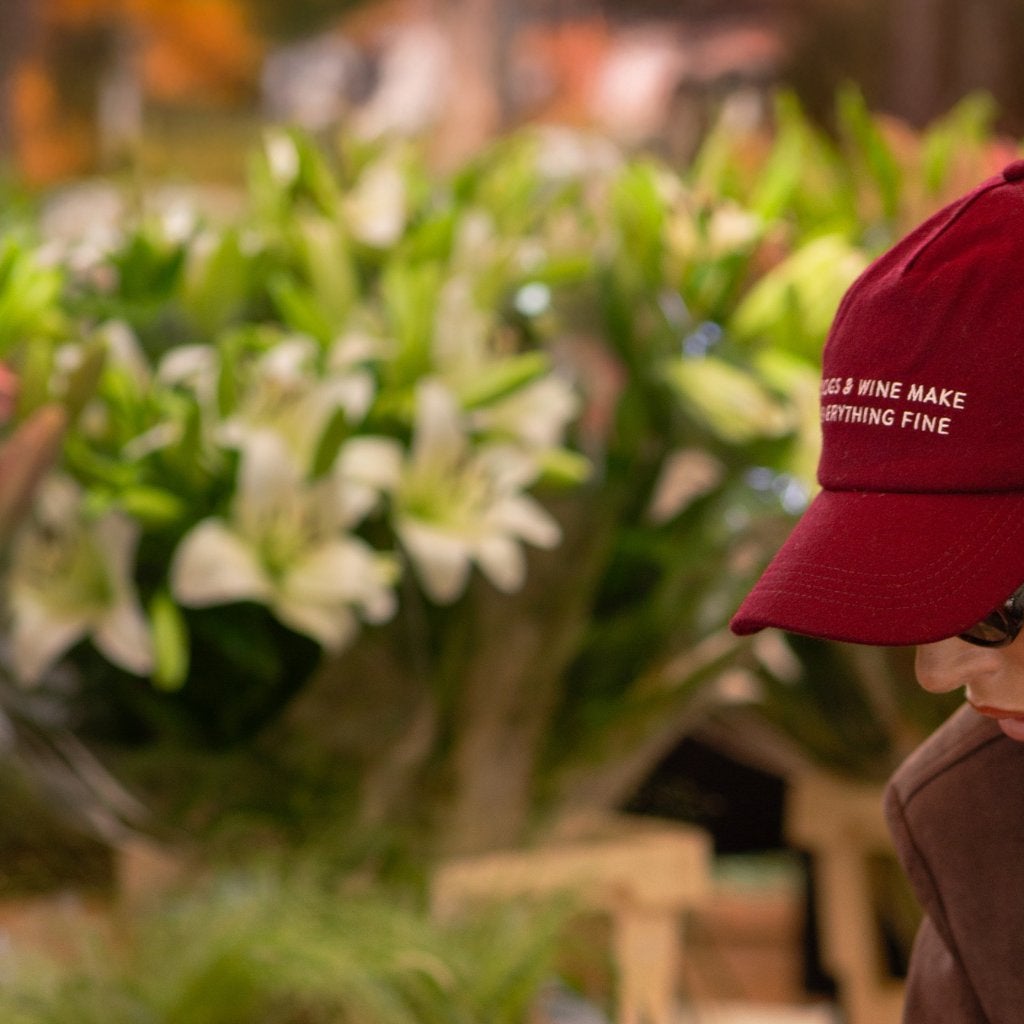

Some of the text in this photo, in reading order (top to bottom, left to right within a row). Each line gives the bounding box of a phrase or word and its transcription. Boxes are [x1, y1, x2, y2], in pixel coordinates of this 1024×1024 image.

[842, 377, 854, 395] &
[857, 379, 903, 399] WINE
[907, 383, 967, 409] MAKE
[821, 404, 952, 435] ERYTHING FINE
